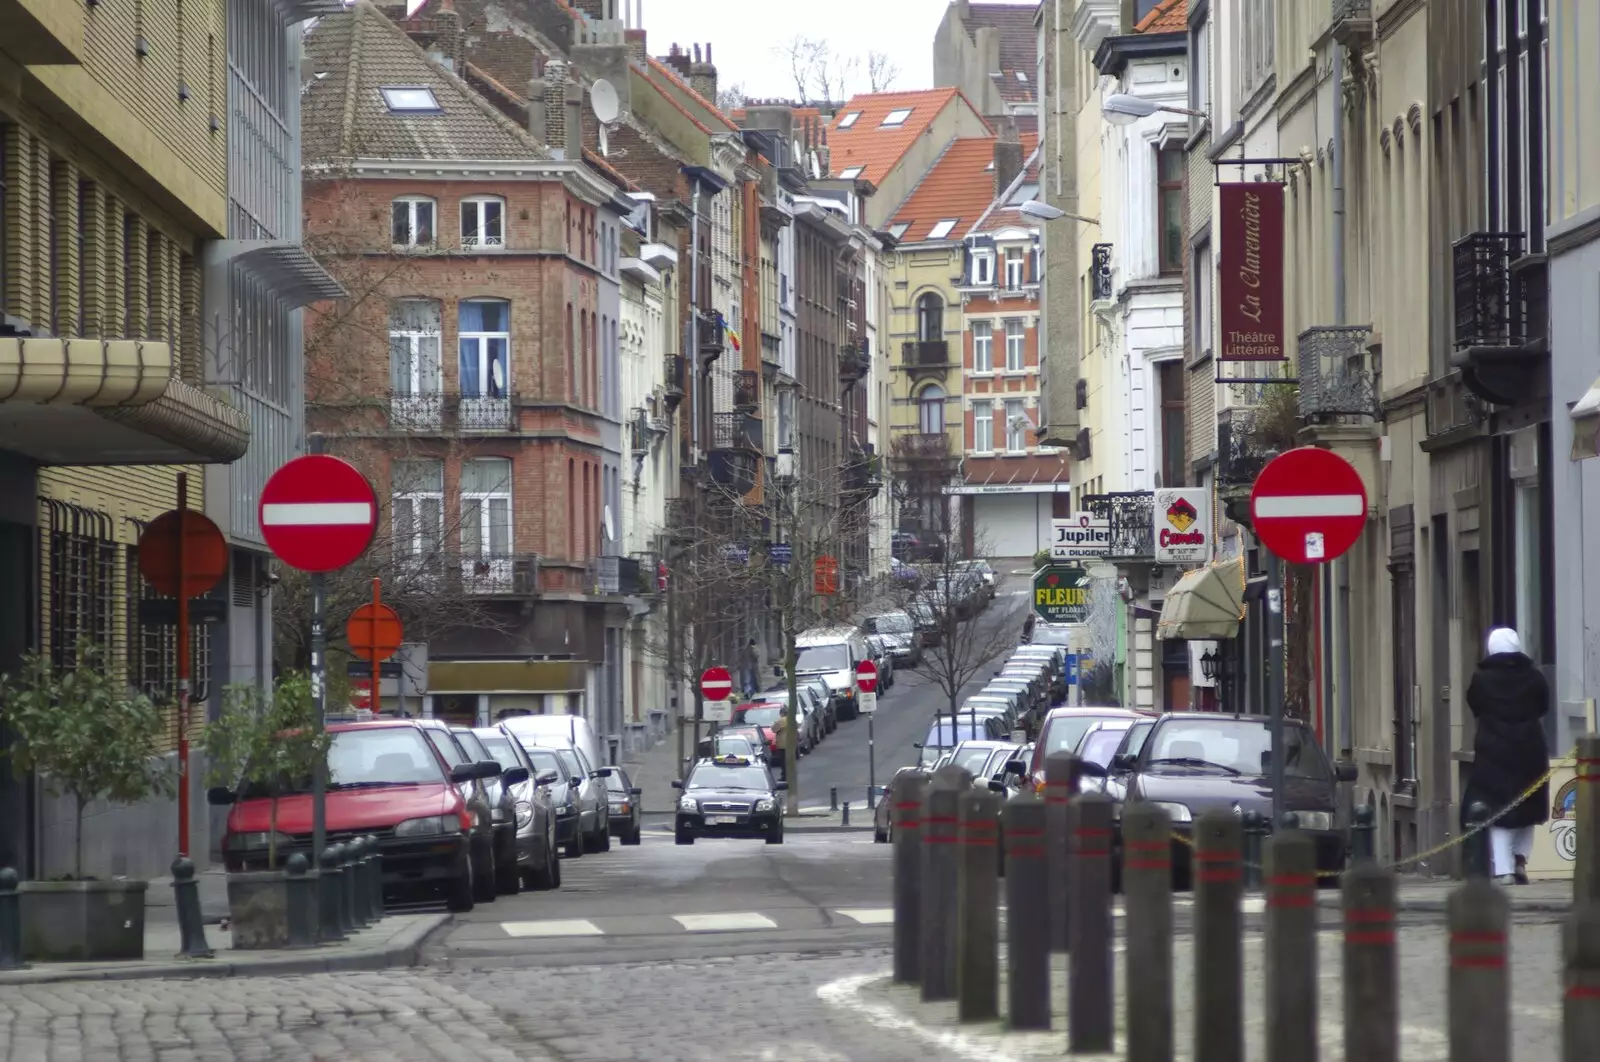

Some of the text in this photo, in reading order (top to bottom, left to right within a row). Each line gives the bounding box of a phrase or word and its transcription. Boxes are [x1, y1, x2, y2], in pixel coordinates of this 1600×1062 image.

[1240, 191, 1262, 323] La Clarencière
[1229, 331, 1276, 343] Théâtre
[1226, 343, 1280, 355] Littéraire
[1057, 528, 1110, 545] Jupiler
